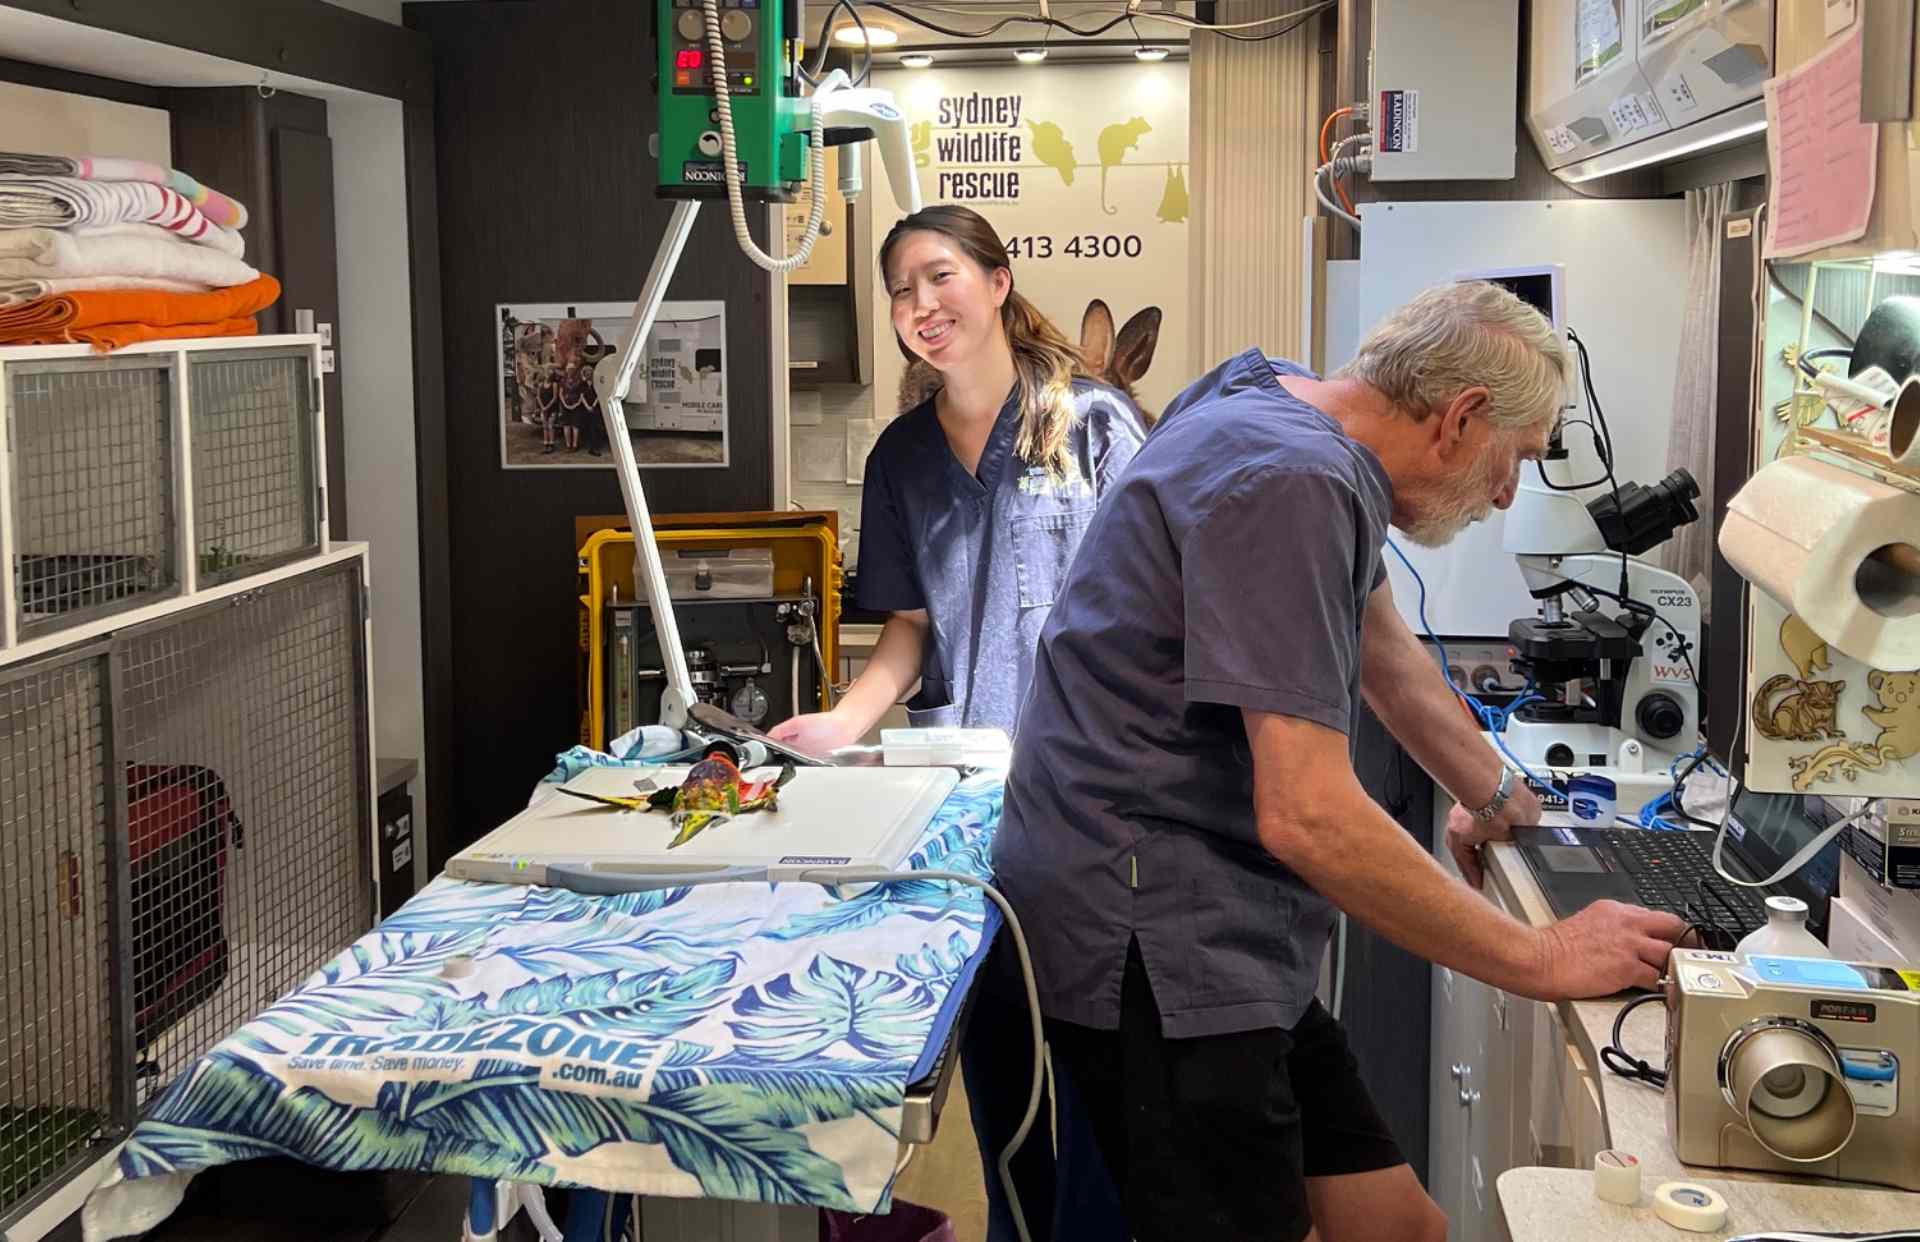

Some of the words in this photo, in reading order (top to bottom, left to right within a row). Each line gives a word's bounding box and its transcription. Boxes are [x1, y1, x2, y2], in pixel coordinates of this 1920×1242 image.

[939, 92, 1022, 128] sydney
[1392, 94, 1402, 150] RADINCON
[937, 132, 1021, 163] wildlife
[939, 172, 1019, 199] rescue
[1064, 235, 1142, 259] 4300
[1657, 596, 1692, 607] CX23
[302, 1018, 662, 1069] TRADEZONE
[288, 1056, 327, 1070] Save
[370, 1056, 408, 1071] Save
[412, 1056, 465, 1072] money.
[552, 1063, 643, 1090] .com.au
